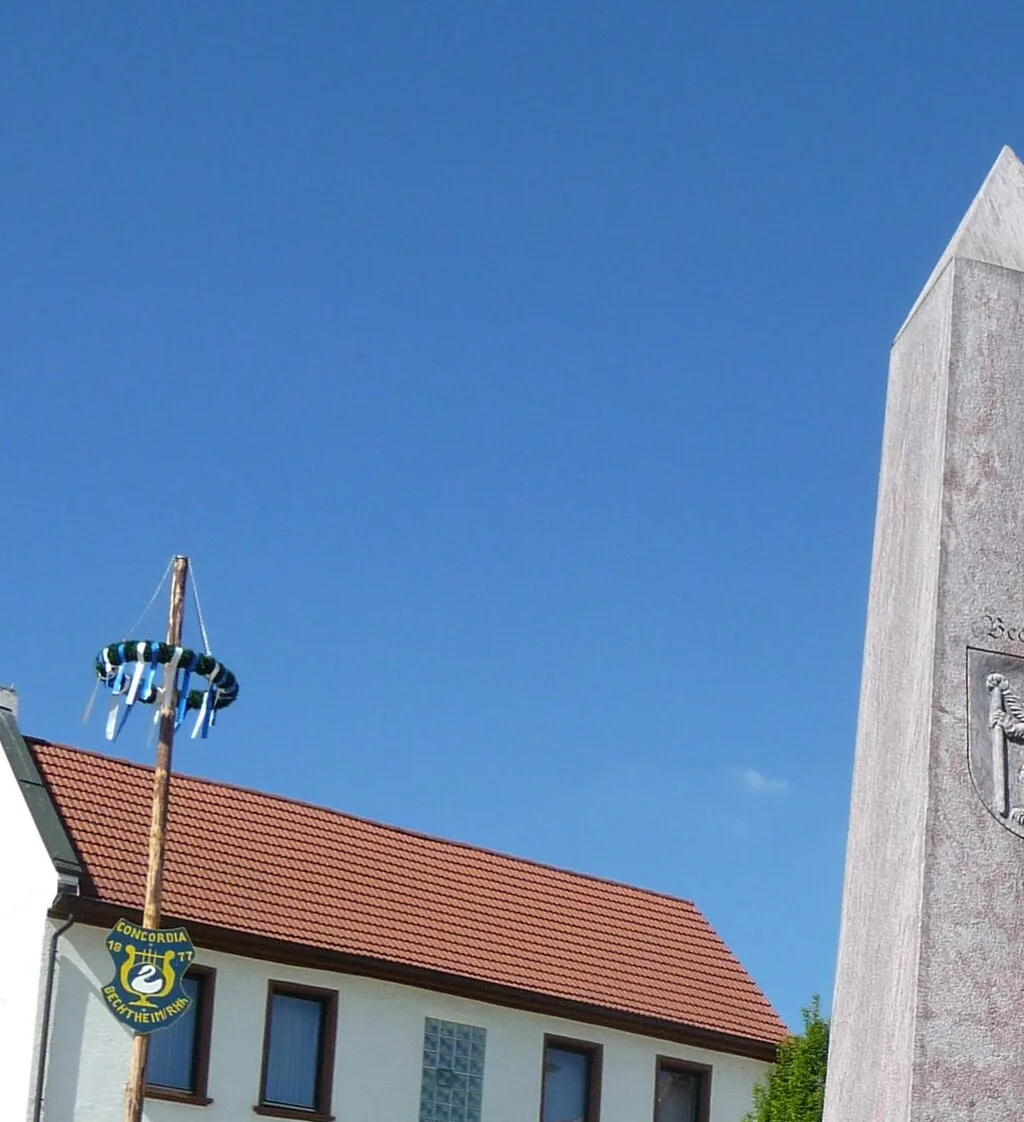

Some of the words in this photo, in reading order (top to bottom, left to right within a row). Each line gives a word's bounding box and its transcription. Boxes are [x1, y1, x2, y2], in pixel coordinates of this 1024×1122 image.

[116, 922, 187, 943] CONCORDIA
[107, 940, 122, 952] 18
[177, 951, 193, 962] 77
